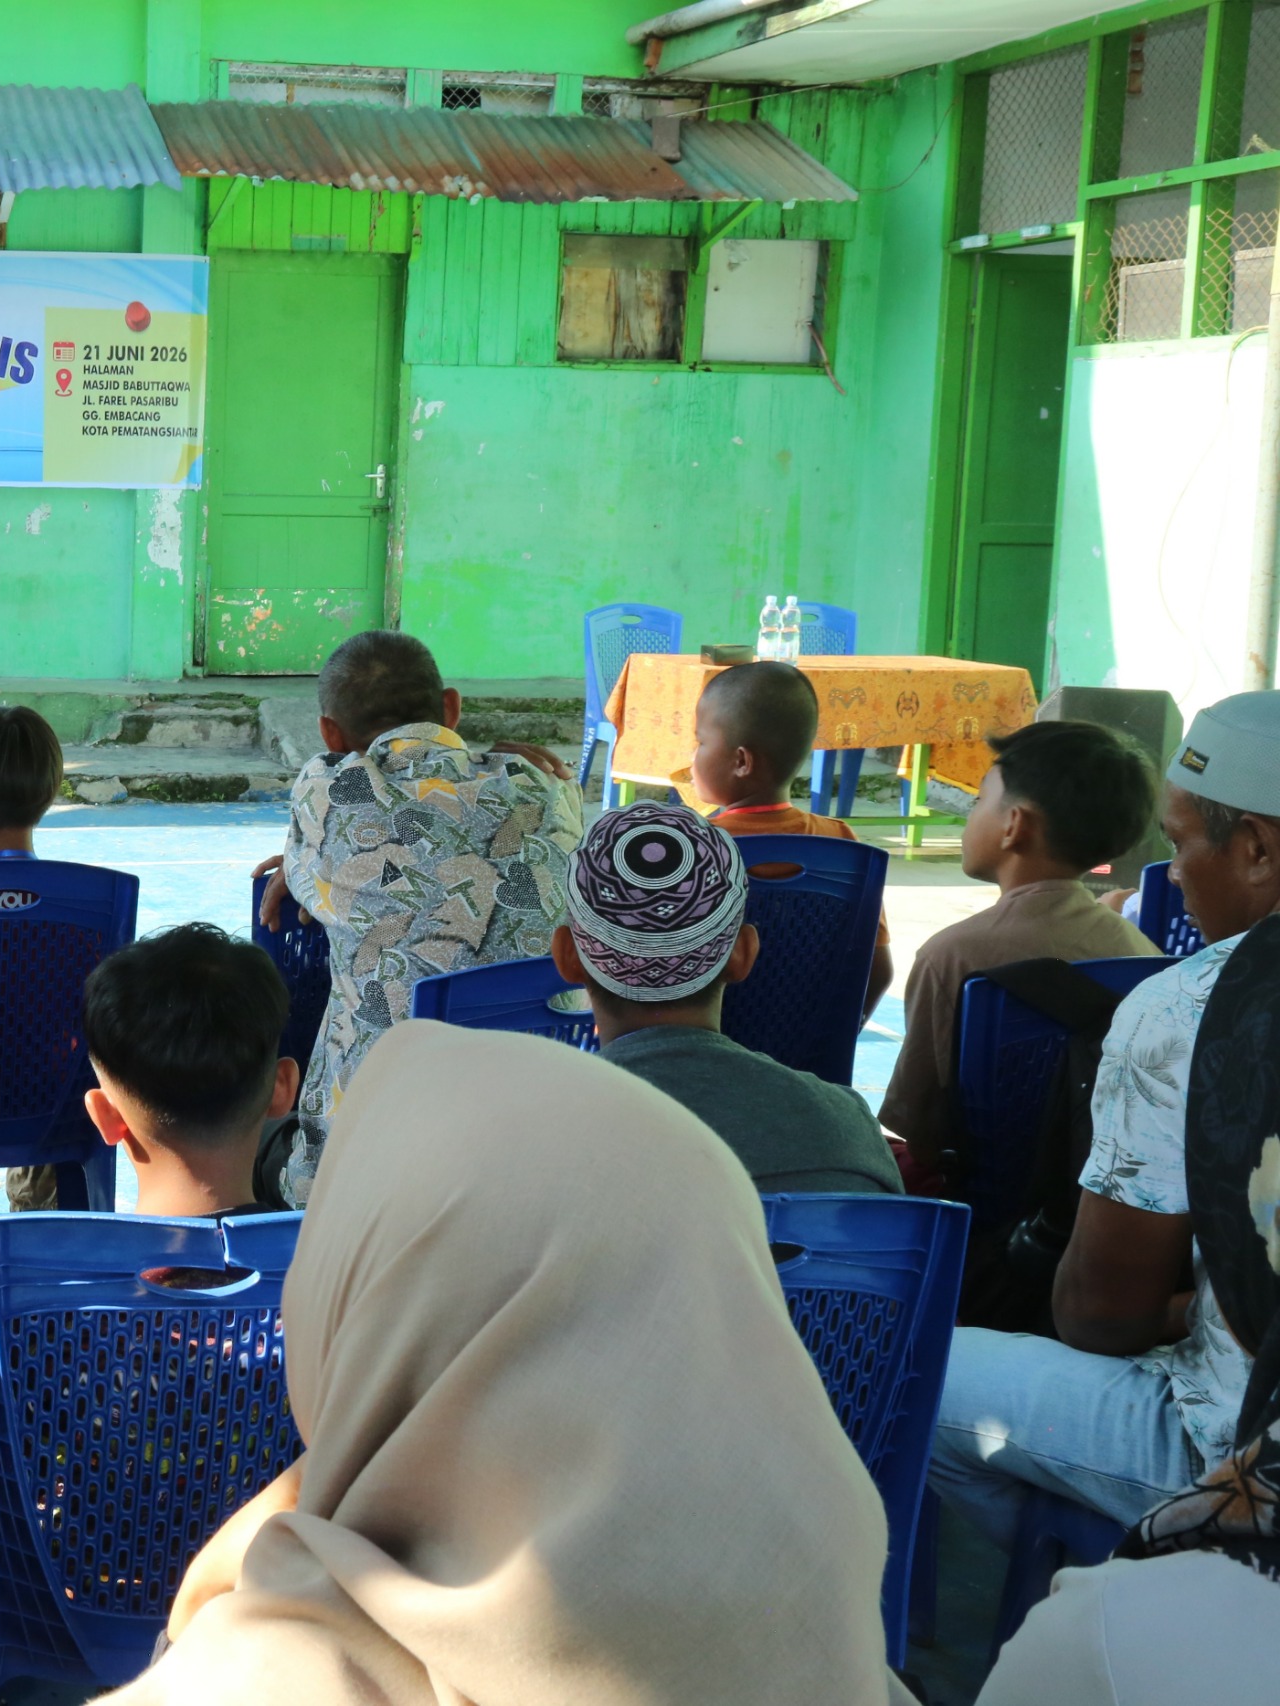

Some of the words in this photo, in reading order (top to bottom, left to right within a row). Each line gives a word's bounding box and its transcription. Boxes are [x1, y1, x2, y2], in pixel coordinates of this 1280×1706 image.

[83, 344, 100, 361] 21
[106, 345, 145, 361] JUNI
[150, 346, 188, 363] 2026
[83, 364, 134, 375] HALAMAN
[82, 380, 120, 391] MASJID
[123, 381, 191, 392] BABUTTAQWA
[82, 395, 95, 406] JL.
[98, 395, 128, 406] FAREL
[130, 396, 179, 407] PASARIBU
[82, 410, 101, 421] GG.
[104, 411, 161, 422] EMBACANG
[82, 426, 109, 436] KOTA
[111, 426, 198, 438] PEMATANGSIANTAR
